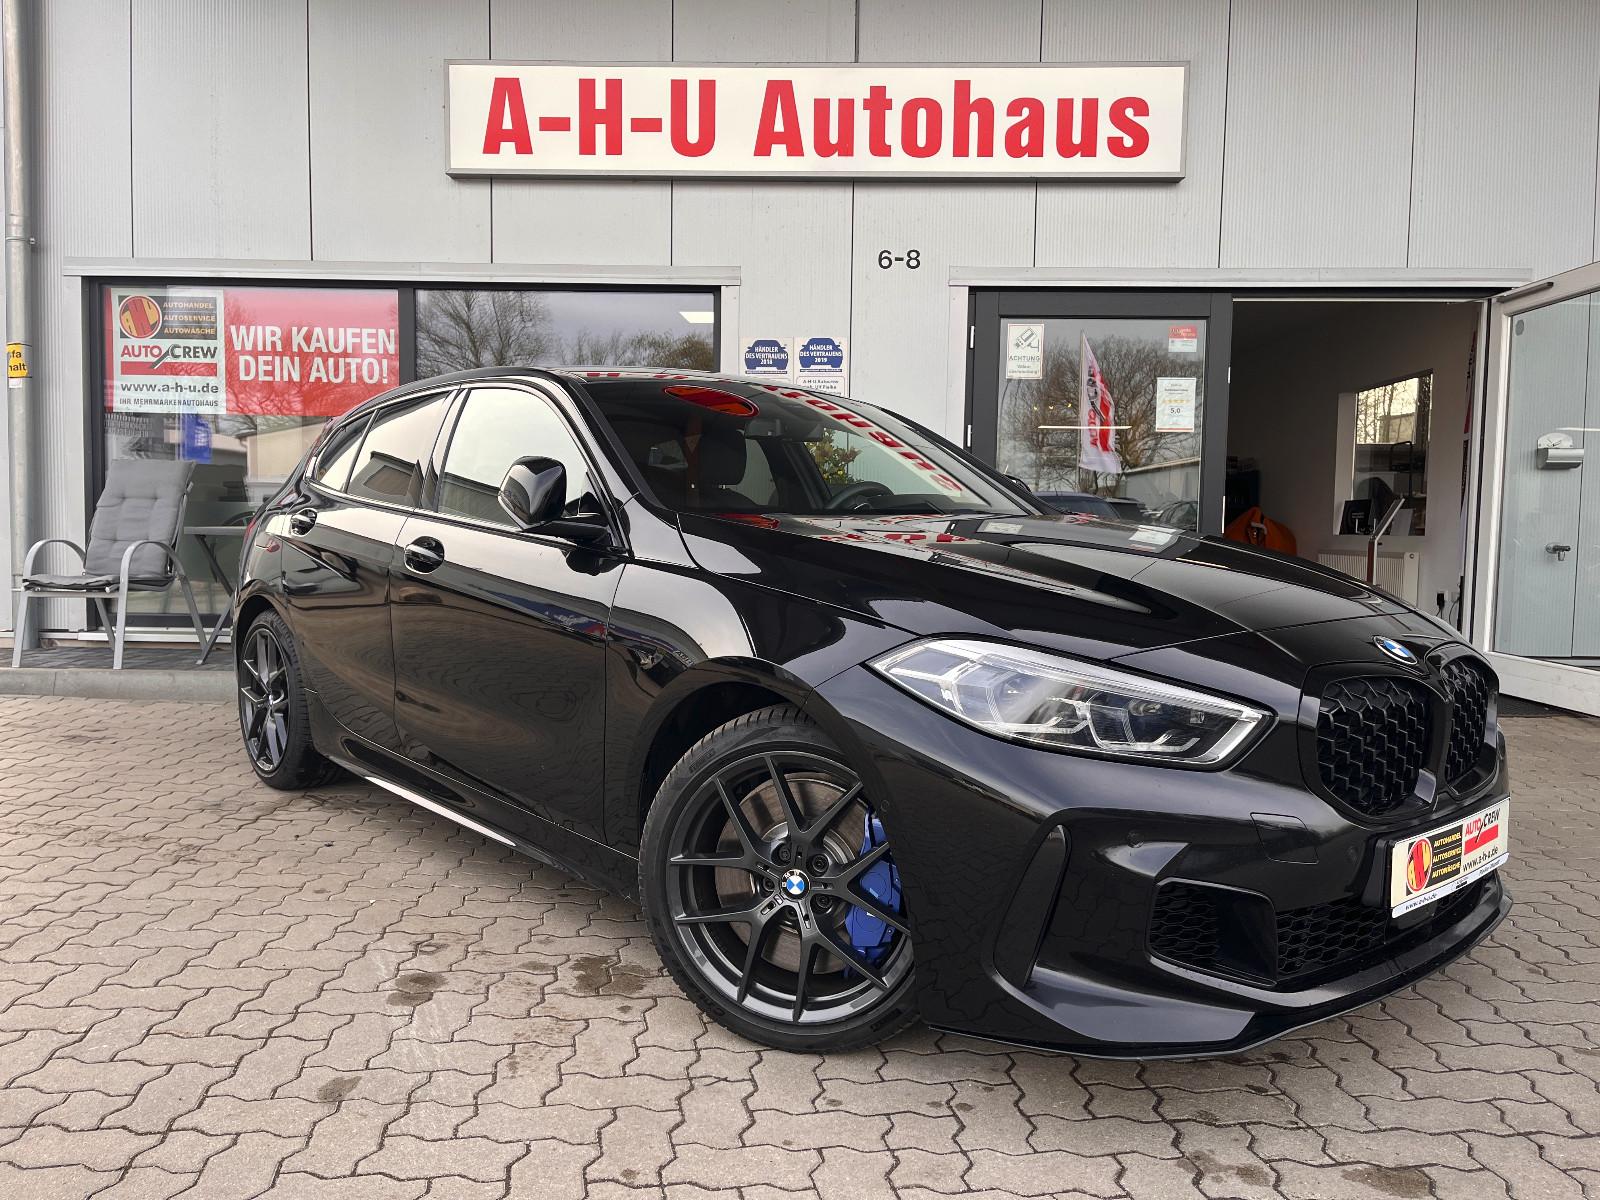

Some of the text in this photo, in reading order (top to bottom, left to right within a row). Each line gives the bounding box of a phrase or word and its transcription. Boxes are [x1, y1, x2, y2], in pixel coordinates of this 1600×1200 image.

[482, 77, 1150, 159] A-H-U Autohaus
[877, 249, 921, 270] 6-8
[163, 314, 216, 322] AUTOSERVICE
[230, 325, 395, 355] WIR KAUFEN
[120, 344, 218, 359] AUTO CREW
[754, 345, 779, 353] HÄNDLER
[239, 355, 388, 384] DEIN AUTO!
[120, 382, 219, 394] www.a-h-u.de
[1433, 832, 1462, 848] AUTOHANDEL
